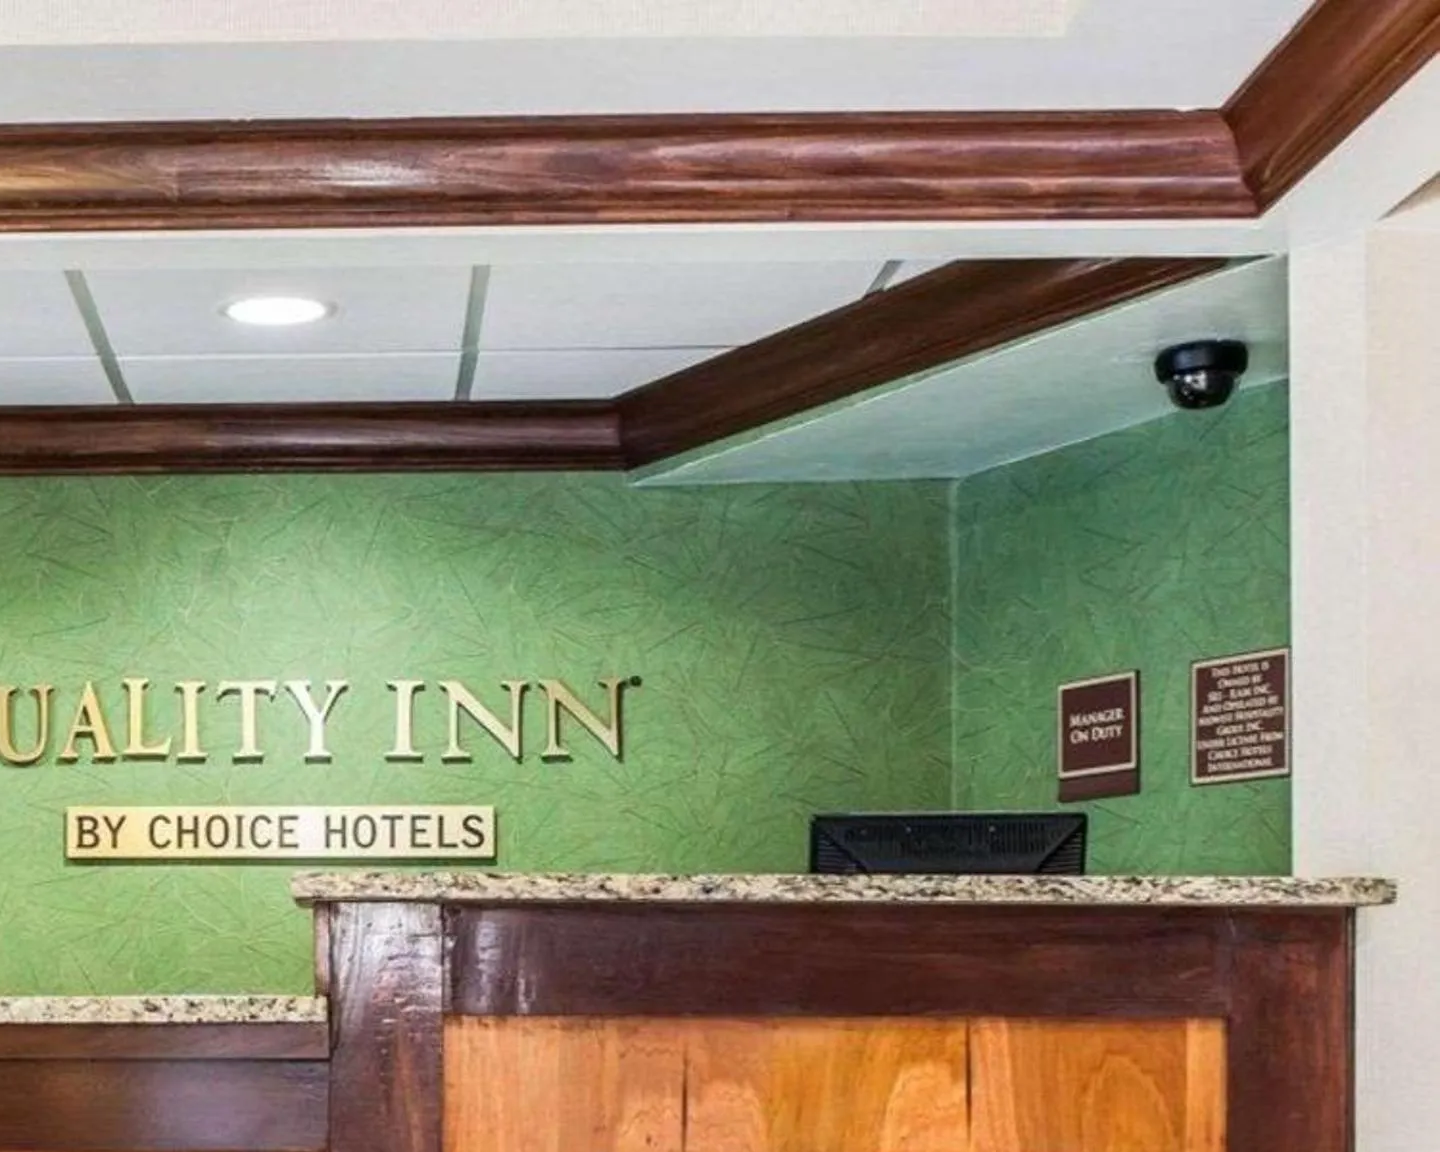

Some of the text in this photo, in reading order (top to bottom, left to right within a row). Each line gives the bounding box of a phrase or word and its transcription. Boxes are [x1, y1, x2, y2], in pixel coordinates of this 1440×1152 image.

[385, 679, 627, 764] INN
[1069, 707, 1125, 728] MANAGER
[1070, 724, 1123, 744] ON DUTY
[75, 814, 486, 850] BY CHOICE HOTELS
